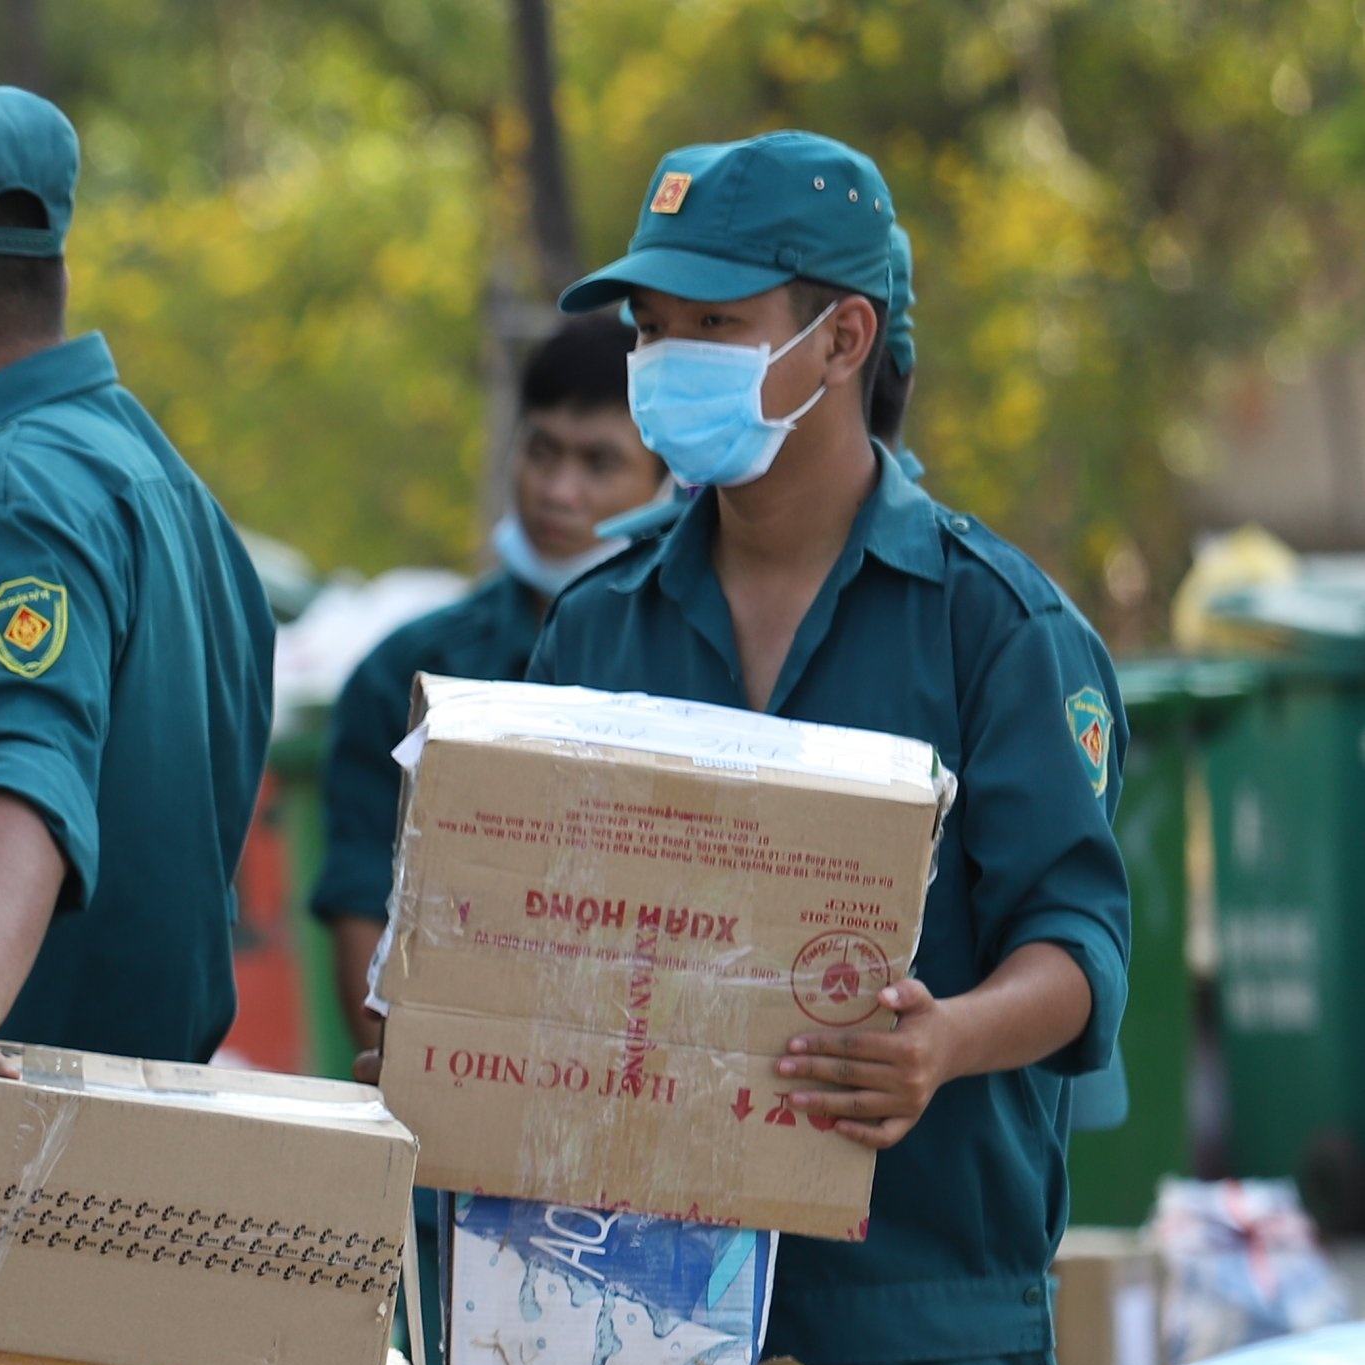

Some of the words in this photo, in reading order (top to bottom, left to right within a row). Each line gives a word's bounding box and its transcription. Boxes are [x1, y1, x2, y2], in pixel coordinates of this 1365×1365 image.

[523, 890, 626, 933] HỒNG
[799, 911, 831, 926] 2015
[824, 898, 881, 917] HACCP
[635, 903, 741, 944] XUÂN
[873, 919, 899, 933] ISO
[422, 1044, 438, 1074] 1
[446, 1047, 528, 1094] NHỎ
